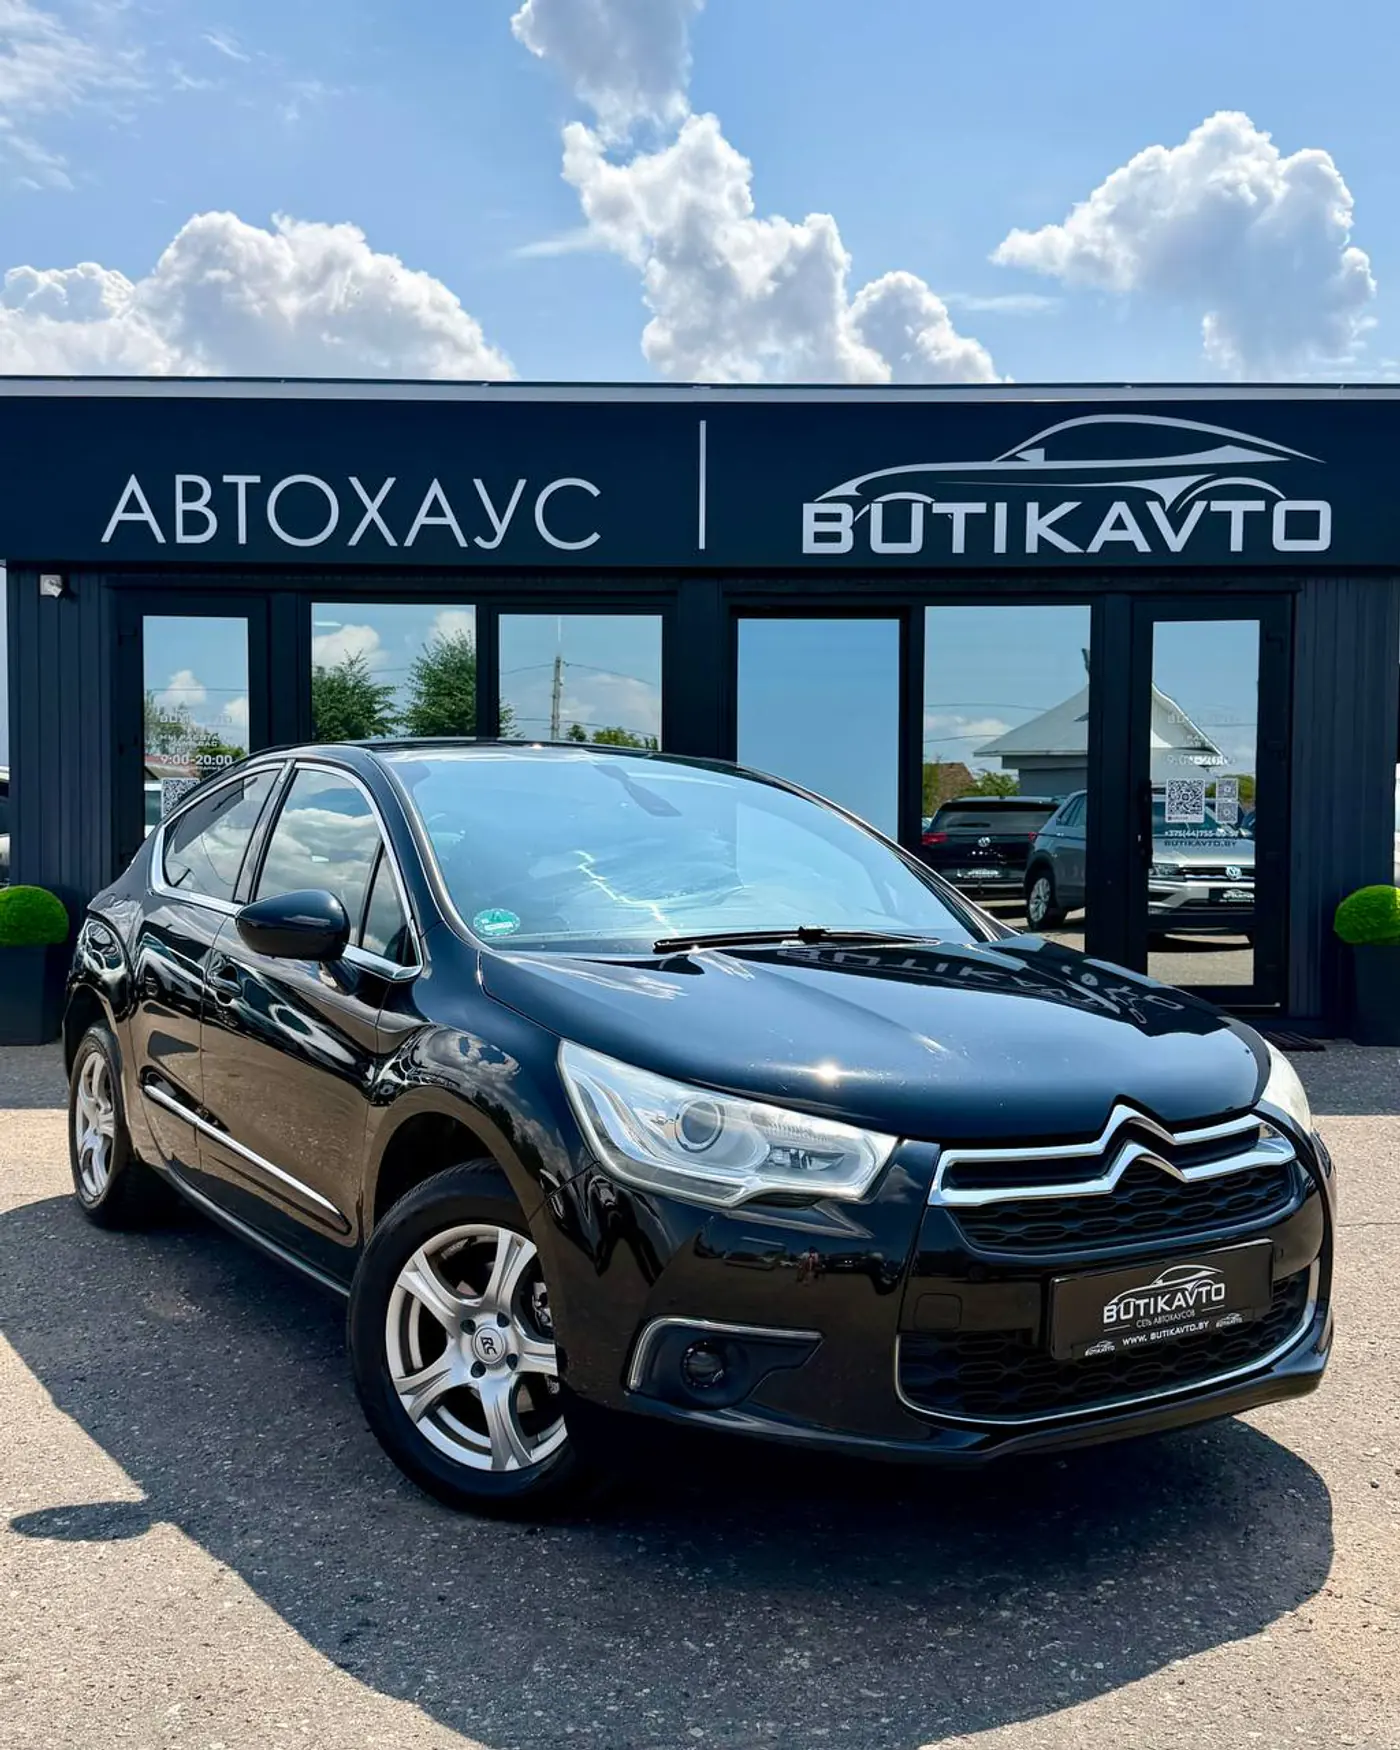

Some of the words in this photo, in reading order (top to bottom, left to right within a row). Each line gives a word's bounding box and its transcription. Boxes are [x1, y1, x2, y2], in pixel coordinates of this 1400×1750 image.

[101, 474, 602, 550] АВТОХАУС
[802, 499, 1332, 554] BUTIKAVTO
[160, 754, 233, 766] 9:00-20:00
[1102, 1283, 1225, 1324] BUTIKAVTO
